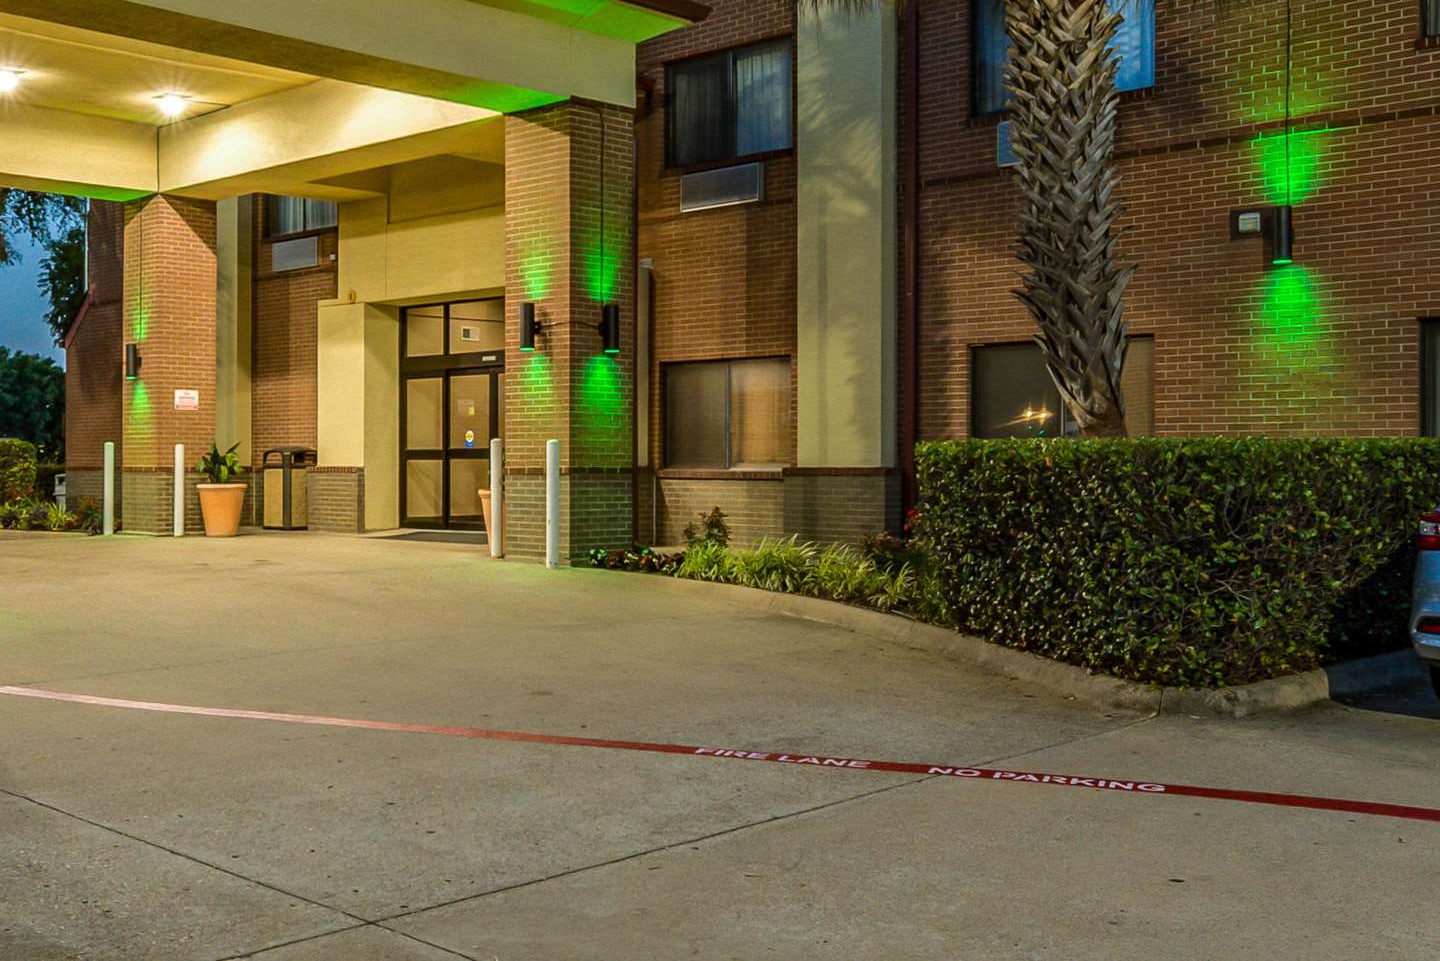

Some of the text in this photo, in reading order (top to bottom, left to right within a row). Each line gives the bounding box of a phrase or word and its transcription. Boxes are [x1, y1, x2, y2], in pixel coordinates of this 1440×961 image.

[695, 748, 1166, 792] FIRE LANE NO PARKING
